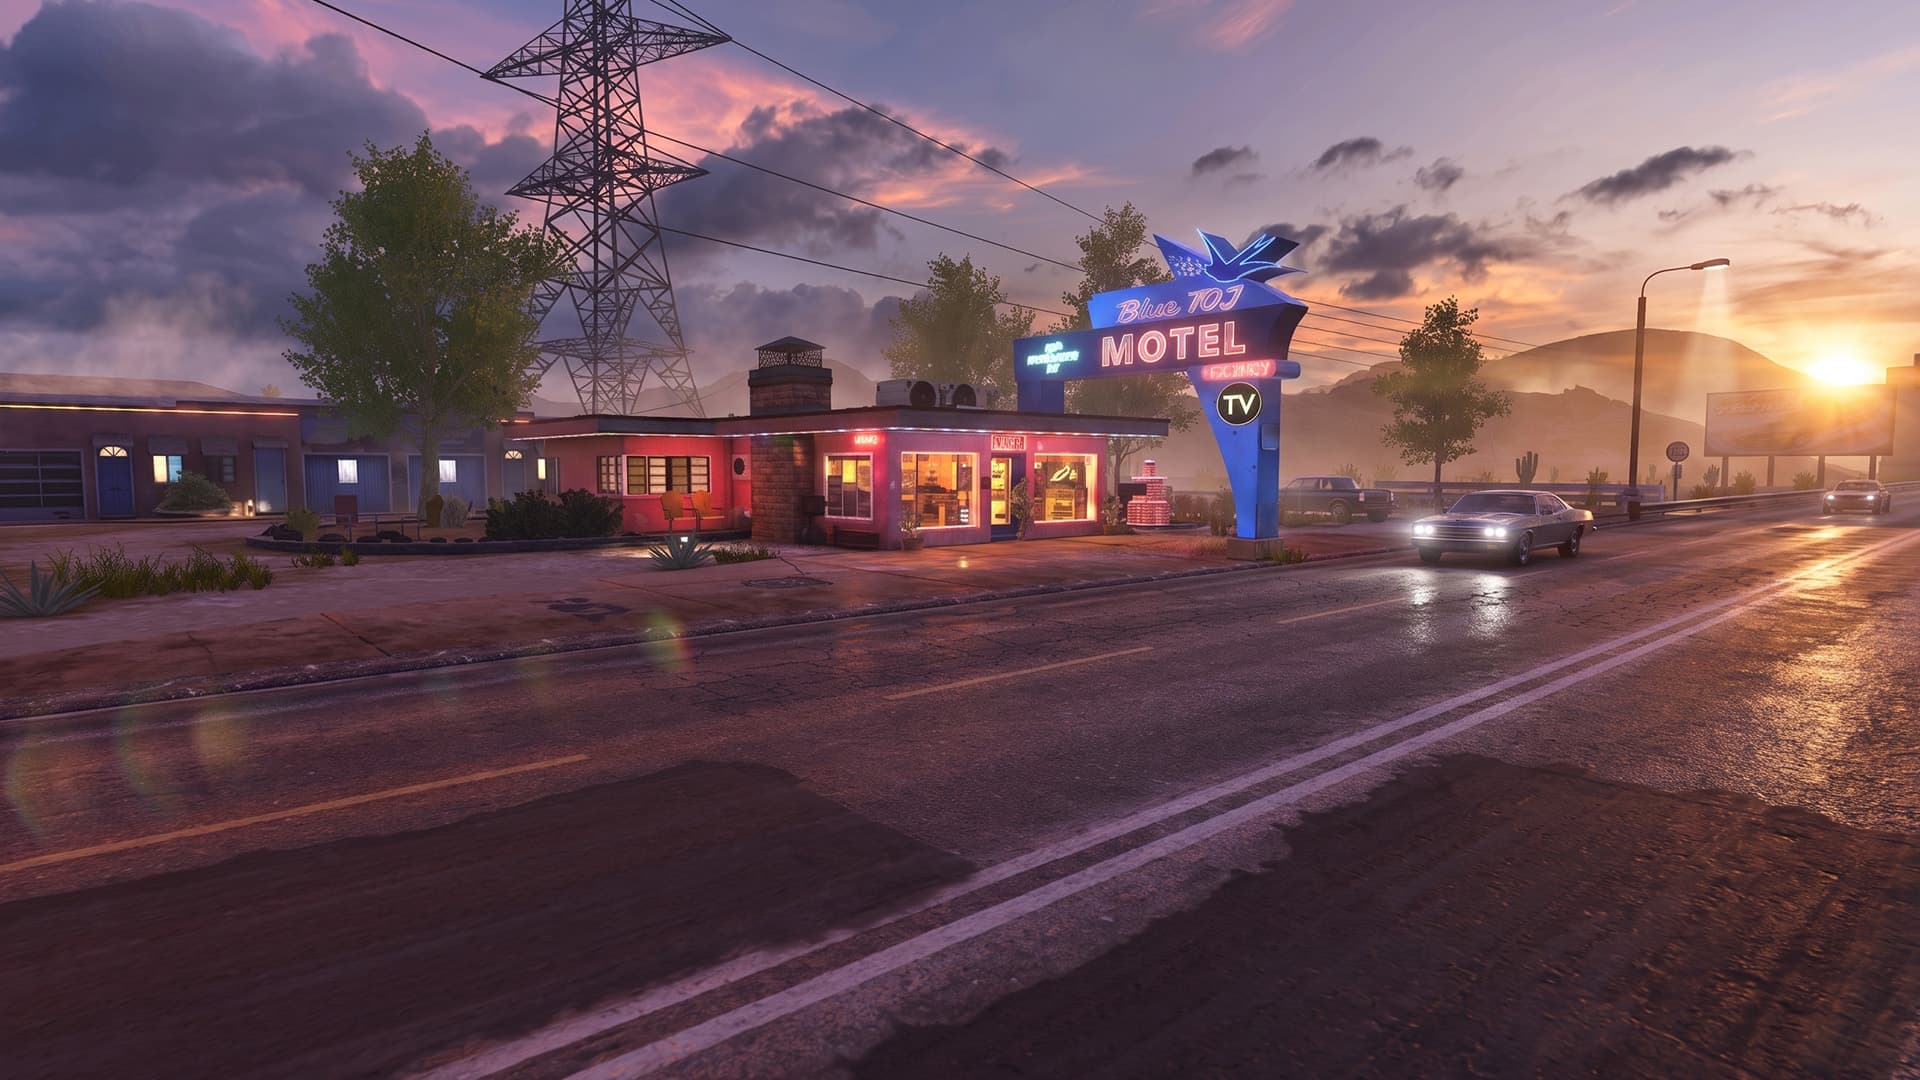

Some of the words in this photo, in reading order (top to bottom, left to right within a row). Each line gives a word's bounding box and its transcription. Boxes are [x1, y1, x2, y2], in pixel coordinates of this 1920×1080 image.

[1116, 297, 1181, 324] Blue
[1101, 320, 1246, 368] MOTEL
[1222, 393, 1257, 416] TV
